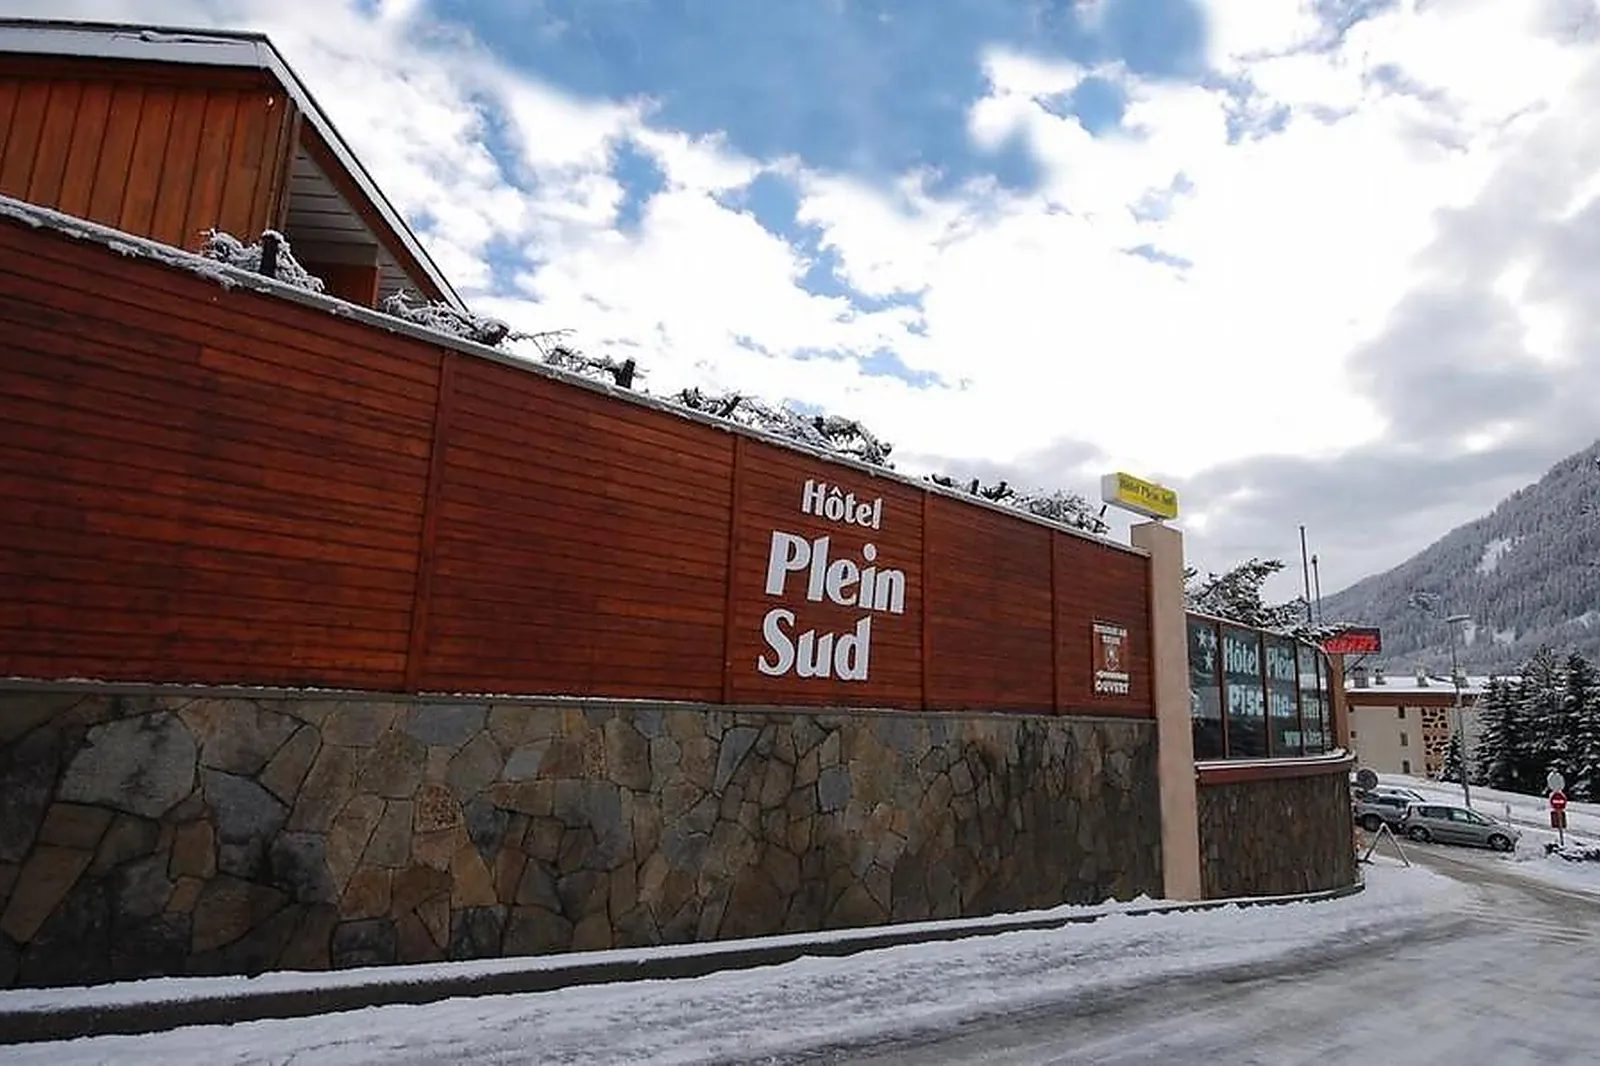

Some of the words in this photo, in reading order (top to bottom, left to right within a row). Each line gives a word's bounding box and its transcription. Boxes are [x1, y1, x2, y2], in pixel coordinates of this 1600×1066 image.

[802, 479, 882, 529] Hôtel
[765, 530, 905, 614] Plein
[758, 608, 871, 681] Sud
[1223, 636, 1260, 676] Hôtel
